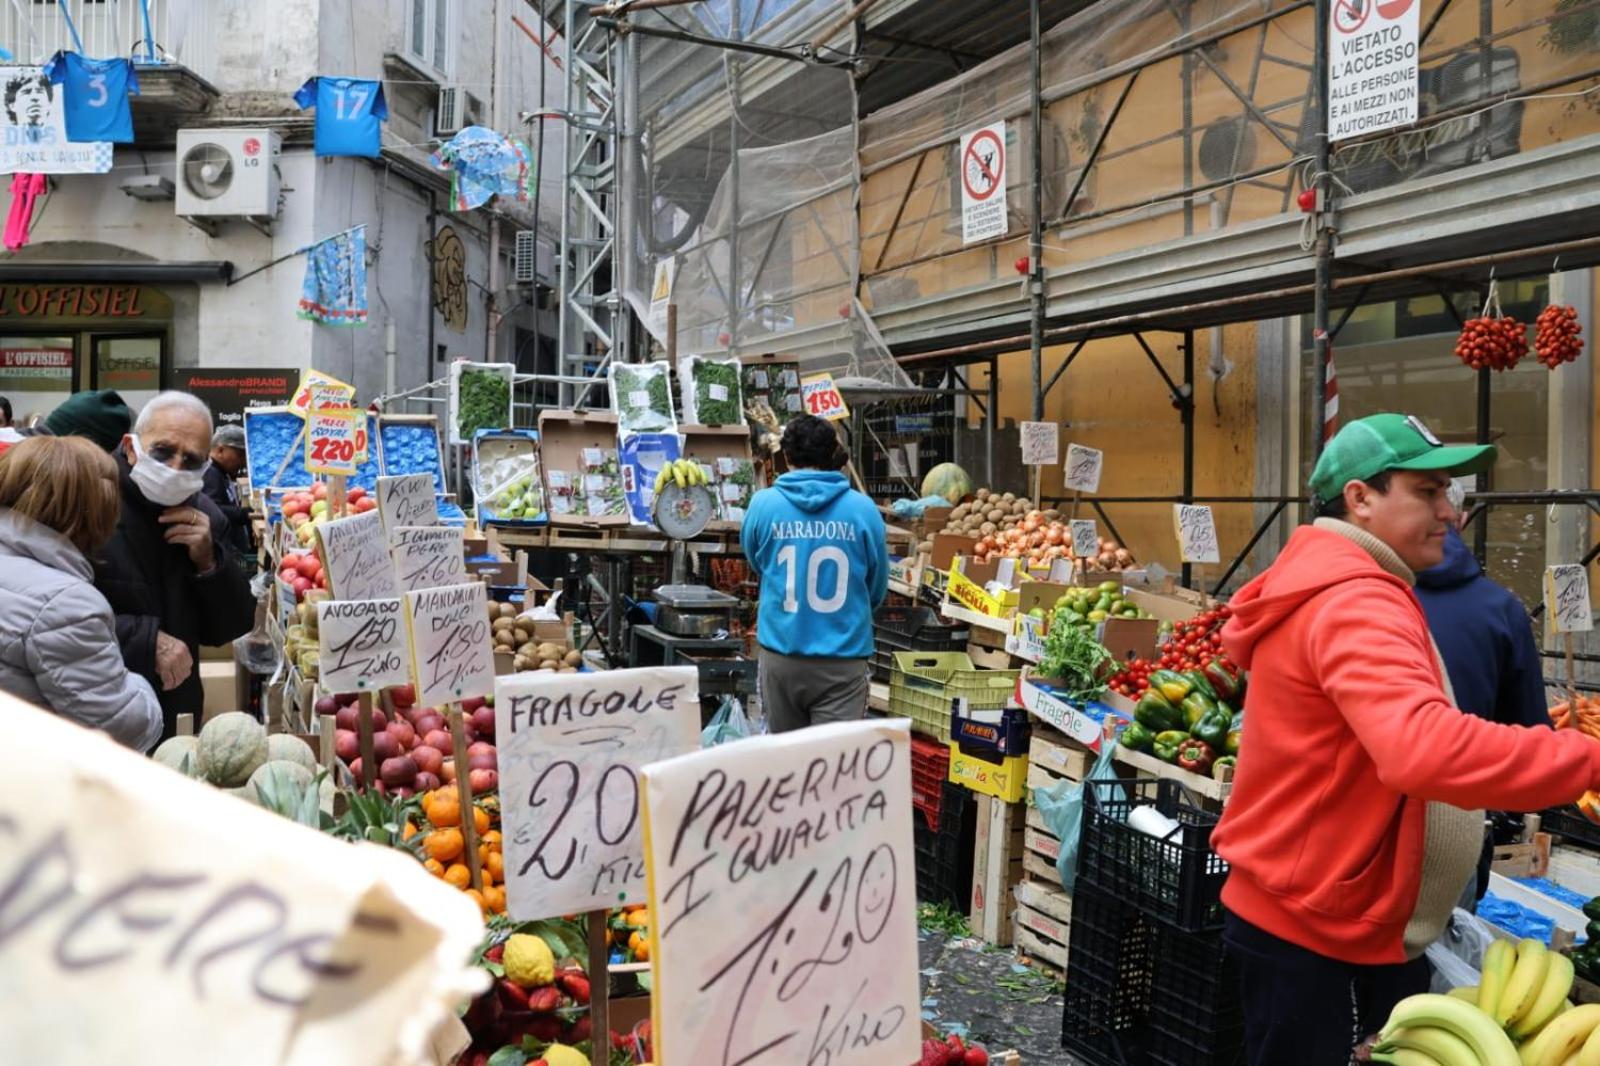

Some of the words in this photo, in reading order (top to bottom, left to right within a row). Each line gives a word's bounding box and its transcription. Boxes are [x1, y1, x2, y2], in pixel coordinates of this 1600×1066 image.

[1342, 25, 1401, 56] VIETATO
[1332, 42, 1415, 80] L'ACCESSO
[88, 74, 108, 107] 3
[1331, 83, 1358, 100] ALLE
[1361, 66, 1415, 92] PERSONE
[334, 89, 369, 120] 17
[1331, 106, 1338, 119] E
[1341, 103, 1351, 117] AI
[1354, 94, 1386, 112] MEZZI
[1390, 86, 1415, 101] NON
[1336, 107, 1408, 135] AUTORIZZATI
[244, 158, 259, 167] LG
[0, 286, 145, 317] L'OFFISIEL
[5, 351, 68, 366] L'OFFISIEL
[807, 390, 840, 415] 150
[772, 520, 856, 542] MARADONA
[777, 545, 849, 613] 10
[508, 685, 685, 733] FRAGOLE
[1036, 692, 1082, 733] Fragole
[669, 739, 894, 868] PALERMO
[729, 789, 887, 883] QUALITA
[592, 856, 645, 895] KIL
